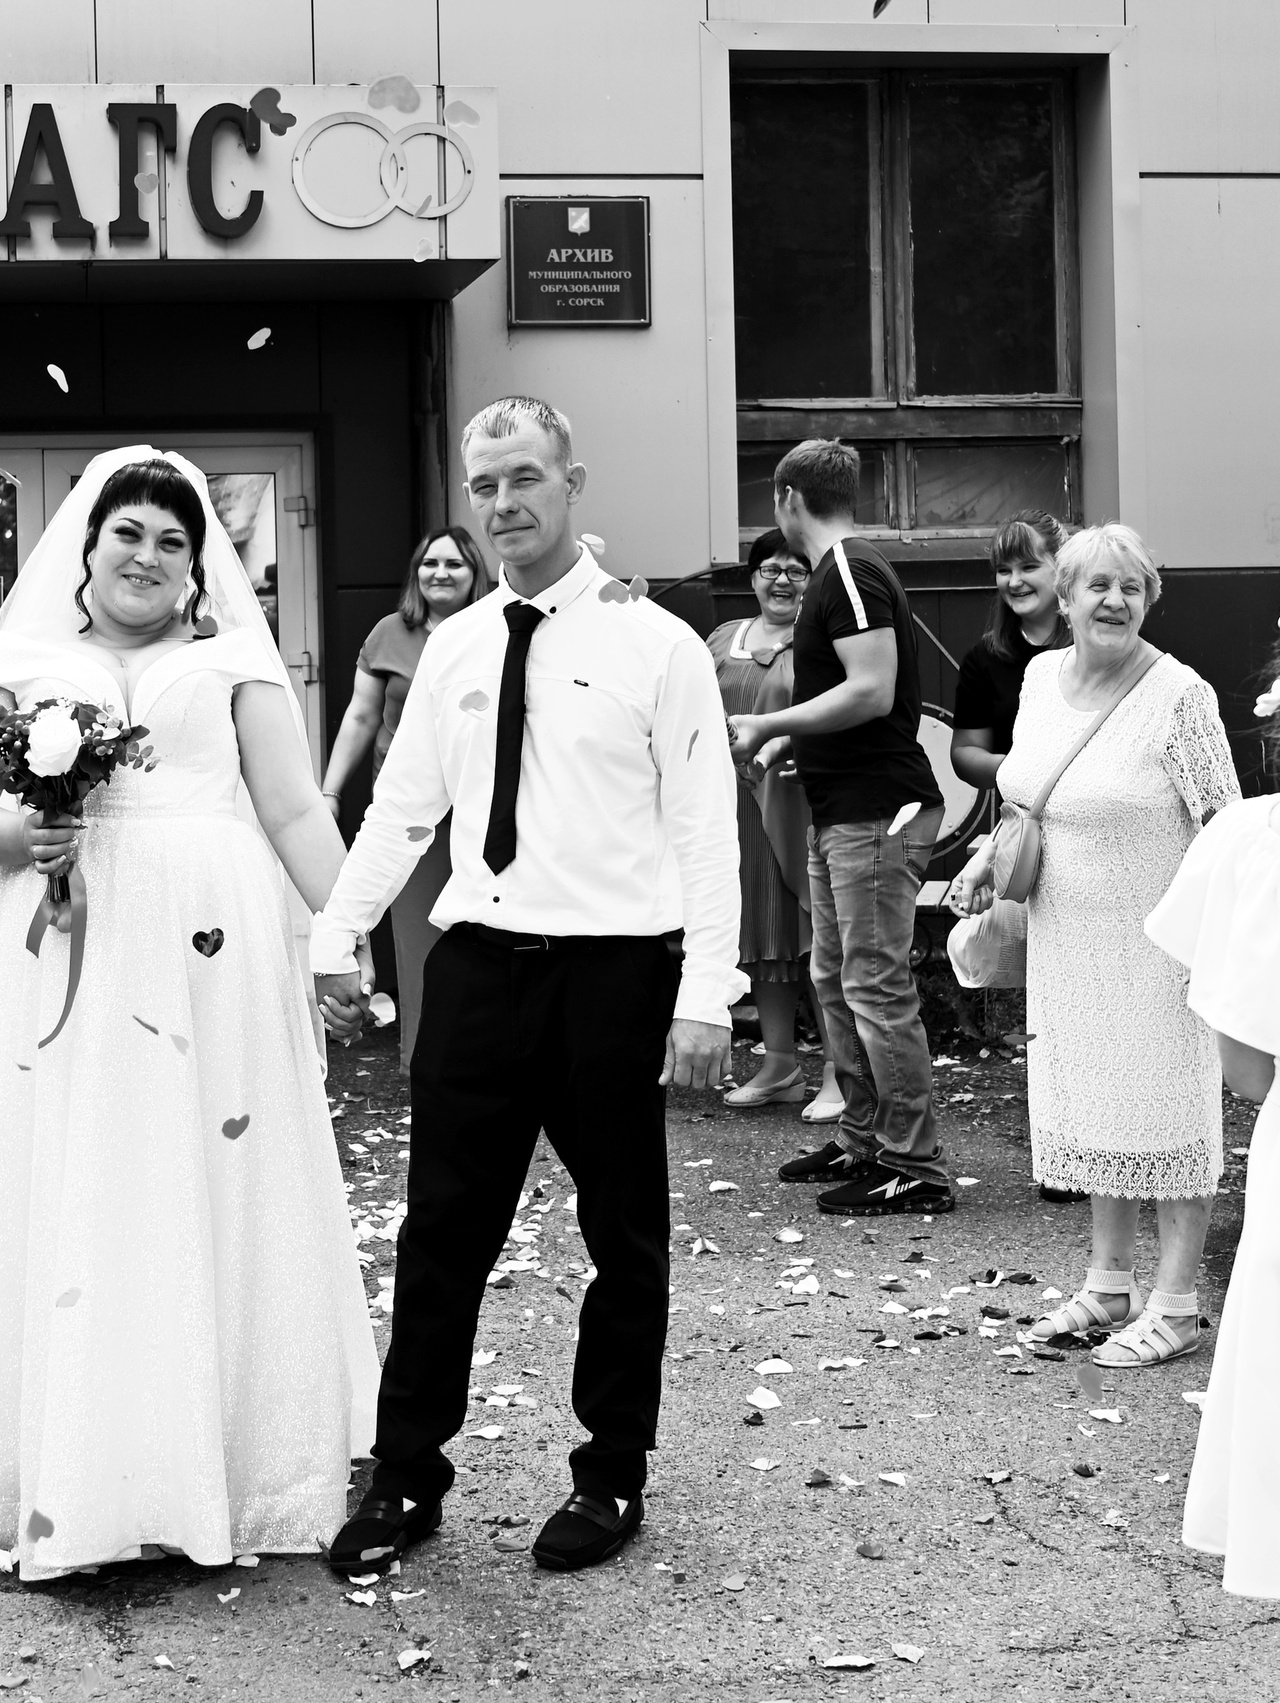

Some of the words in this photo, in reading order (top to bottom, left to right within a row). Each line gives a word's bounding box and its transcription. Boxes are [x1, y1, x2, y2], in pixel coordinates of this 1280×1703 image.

[546, 248, 614, 263] АРХИВ
[528, 271, 632, 280] МУНИЦИПАЛЬНОГО
[540, 284, 620, 293] ОБРАЗОВАНИЯ
[568, 298, 605, 306] СОРСК
